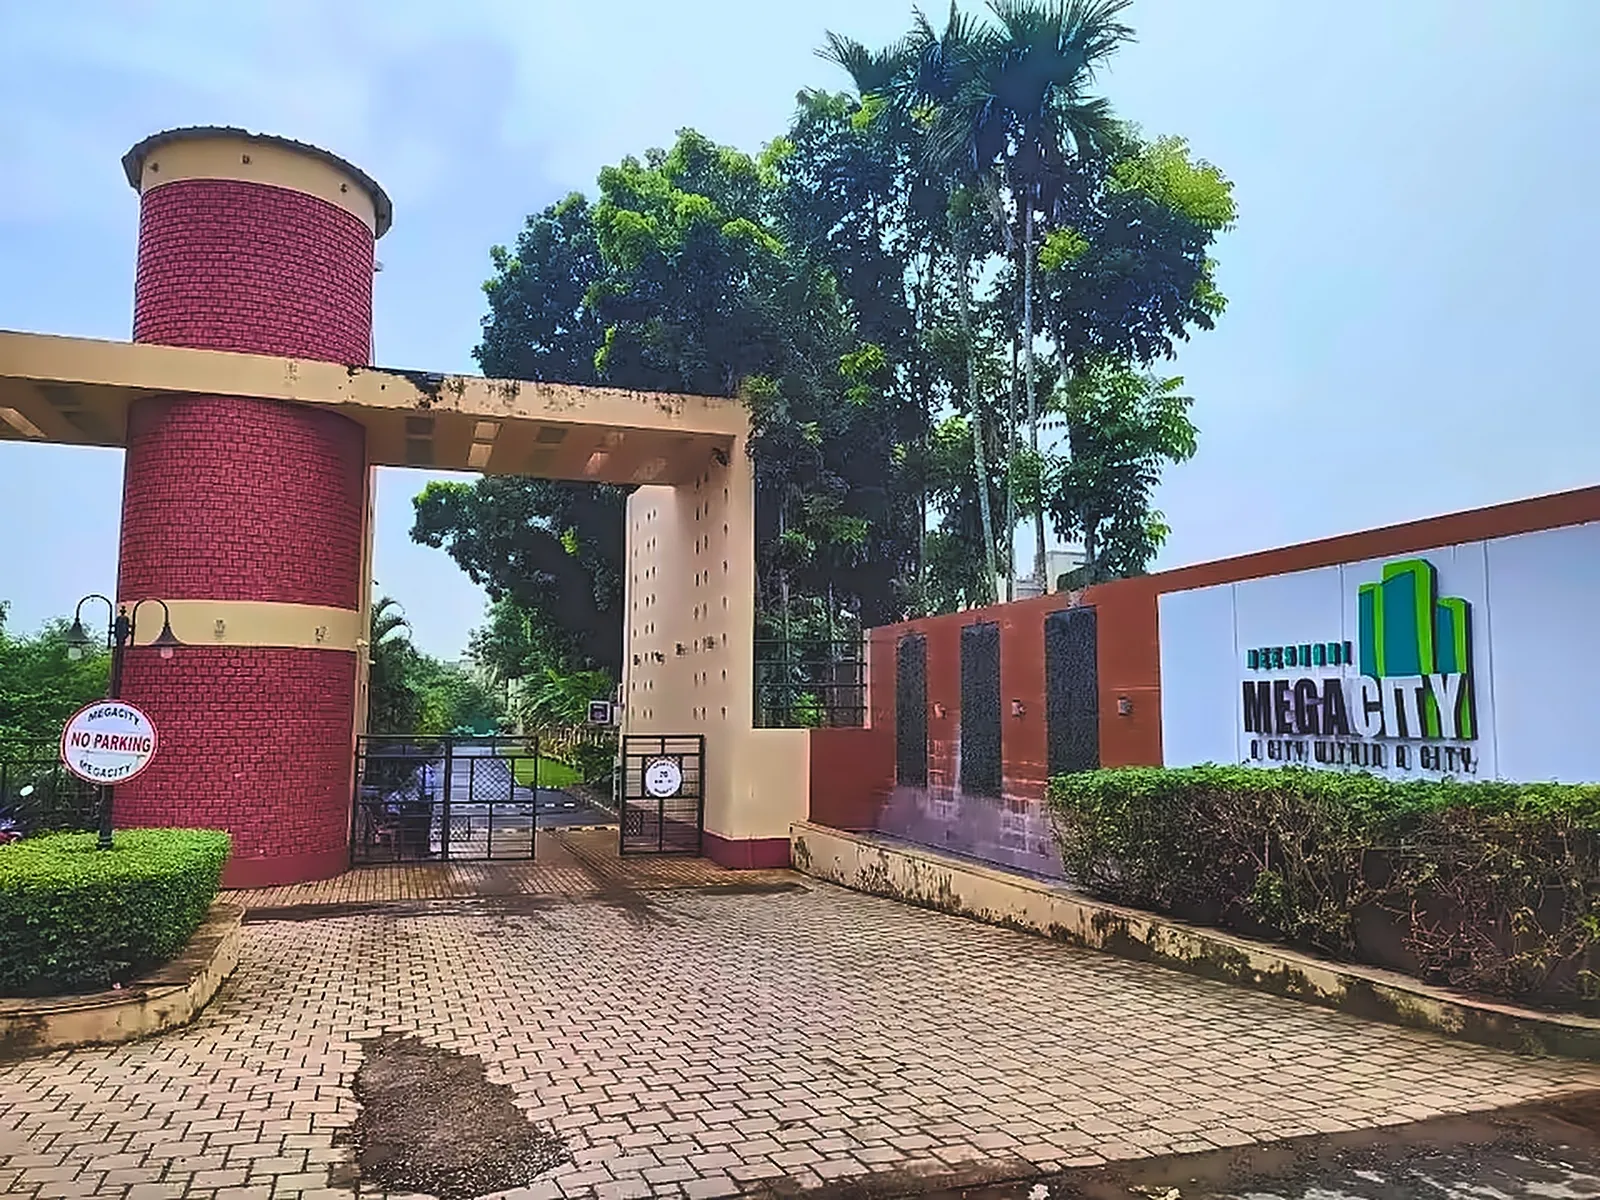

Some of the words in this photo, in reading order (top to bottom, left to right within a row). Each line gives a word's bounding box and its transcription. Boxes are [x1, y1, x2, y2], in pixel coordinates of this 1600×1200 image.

[88, 708, 140, 726] MEGACITY
[1242, 674, 1463, 739] MEGACITY
[71, 732, 90, 748] NO
[94, 734, 151, 753] PARKING
[1267, 740, 1306, 762] CITY
[1419, 746, 1474, 774] CITY
